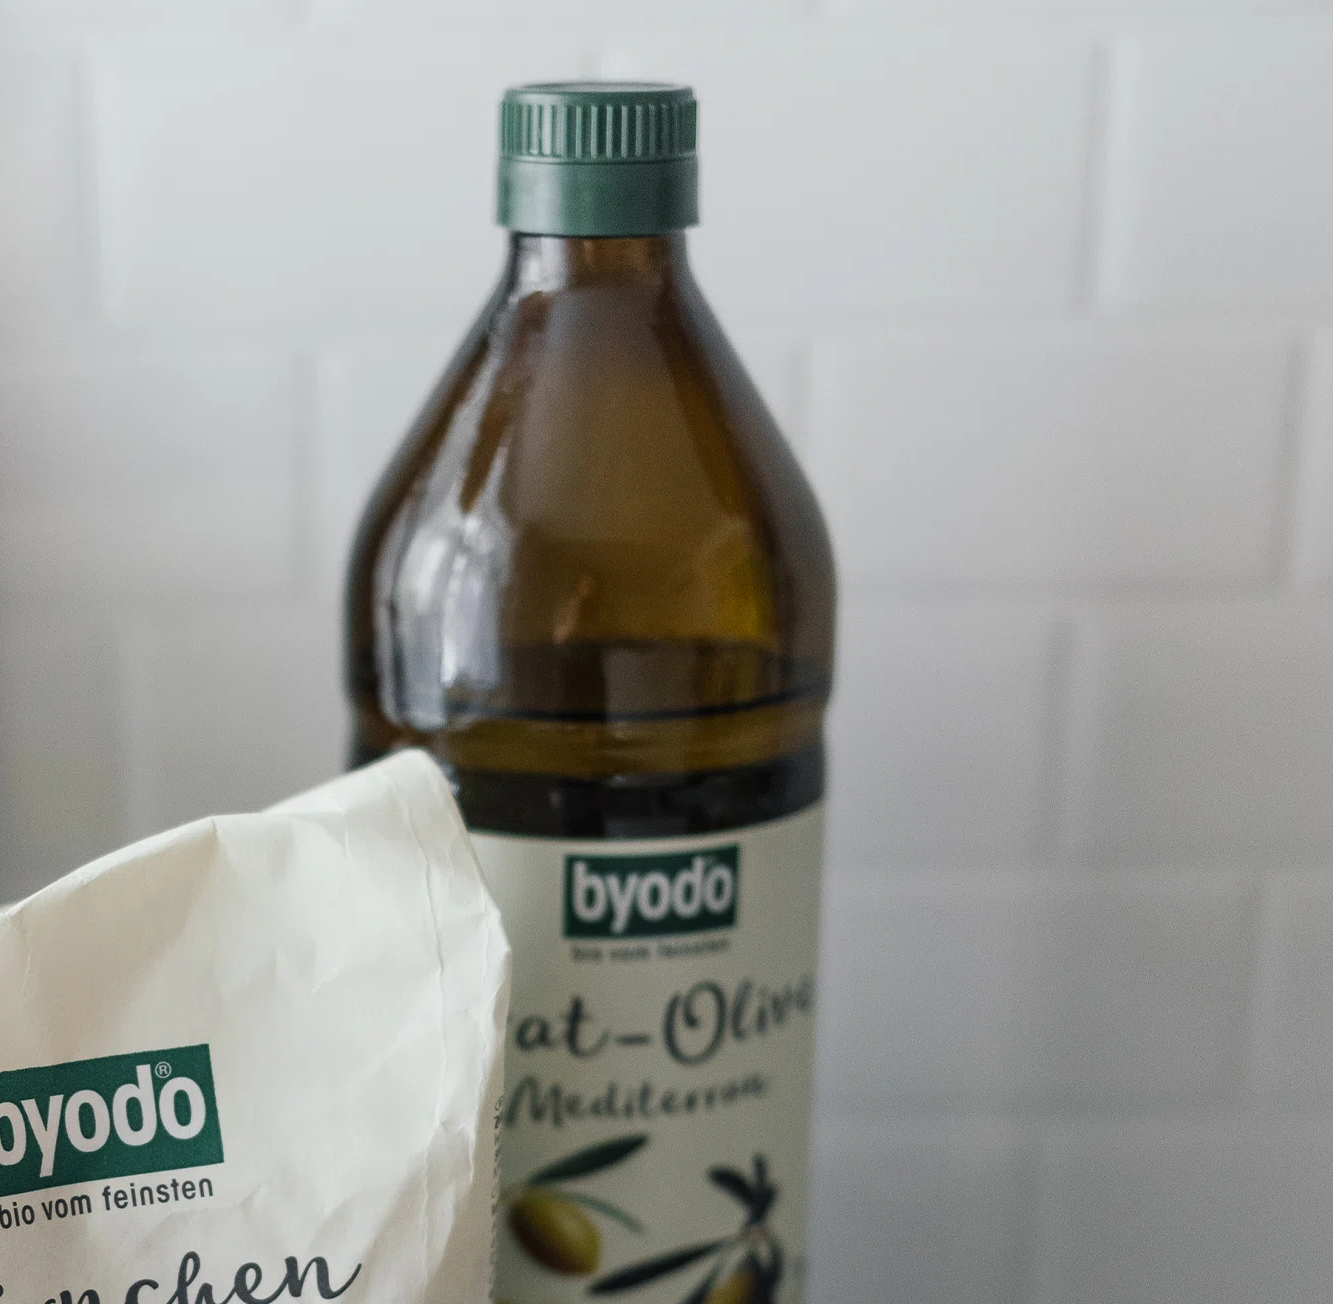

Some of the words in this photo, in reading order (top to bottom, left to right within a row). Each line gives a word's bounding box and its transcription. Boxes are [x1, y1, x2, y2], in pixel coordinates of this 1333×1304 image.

[572, 855, 732, 935] byodo
[41, 1192, 93, 1221] vom
[102, 1176, 214, 1212] feinsten
